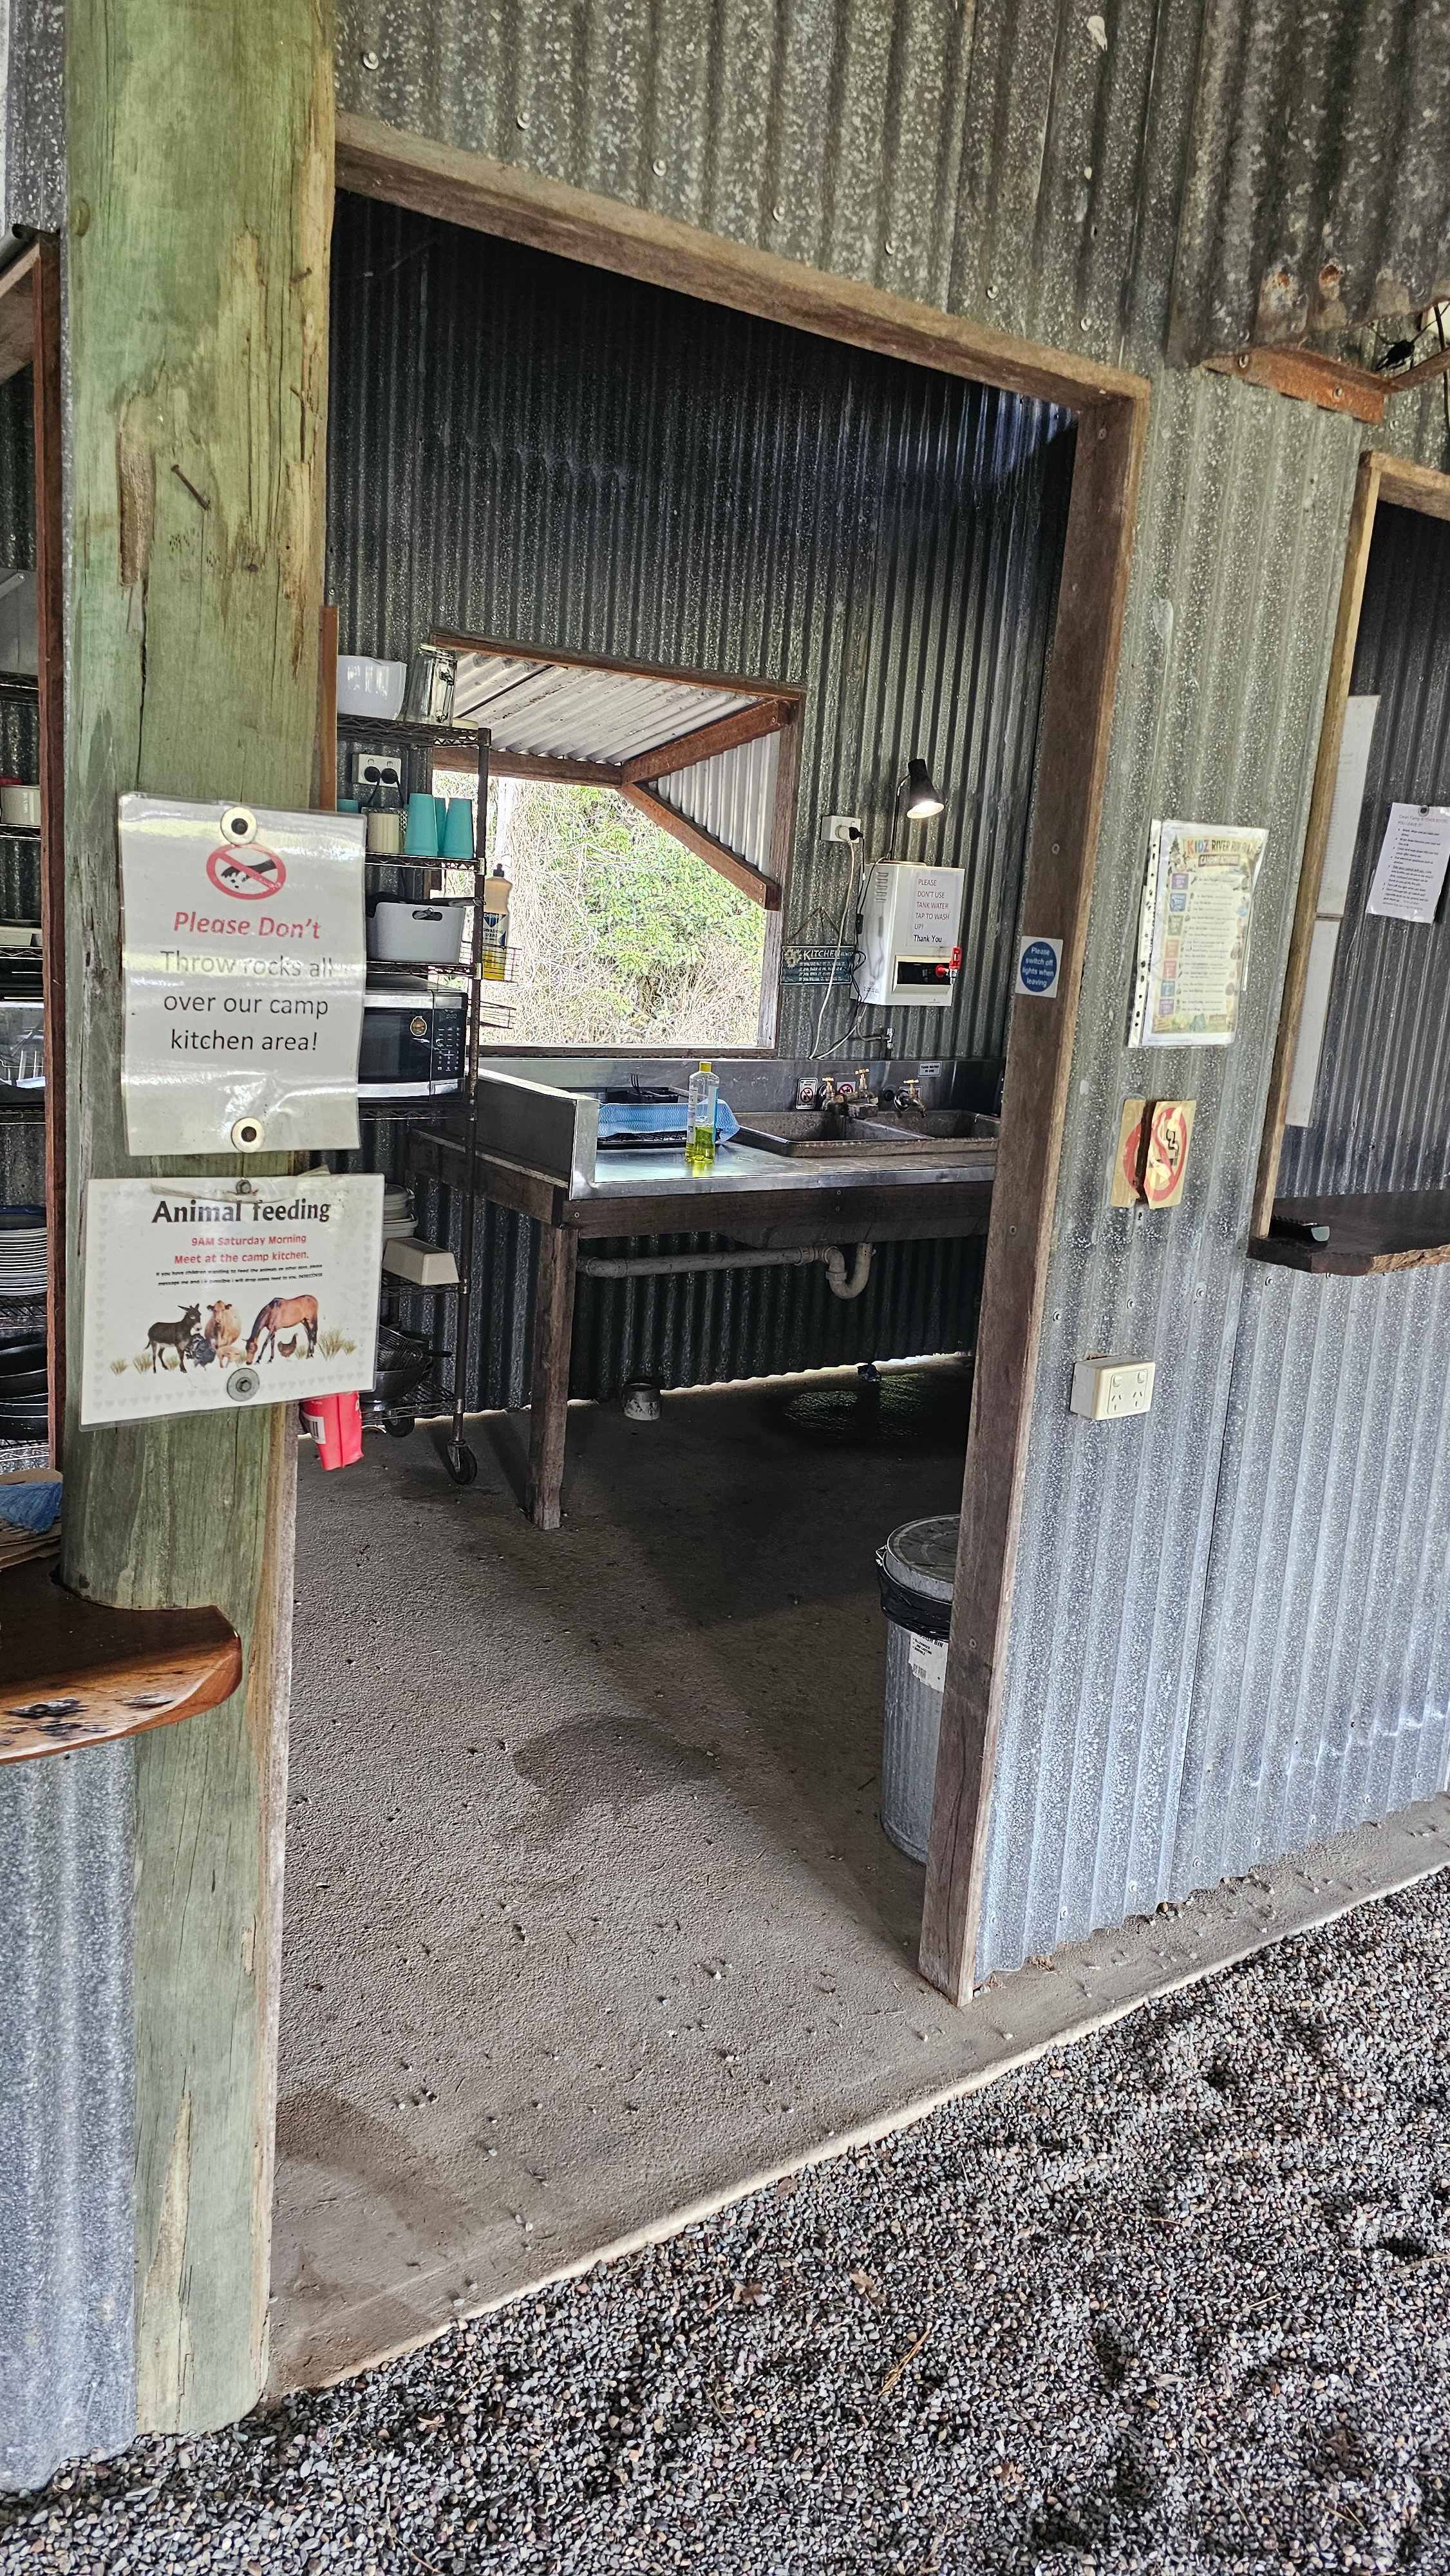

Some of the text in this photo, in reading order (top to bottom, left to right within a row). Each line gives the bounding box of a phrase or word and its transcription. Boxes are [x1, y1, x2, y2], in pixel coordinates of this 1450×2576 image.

[174, 911, 321, 939] Please Don’t
[160, 950, 332, 978] Throw rocks all
[1027, 978, 1047, 987] leaving
[164, 995, 328, 1019] over our camp
[171, 1029, 317, 1050] kitchen area!
[151, 1200, 241, 1224] Animal
[191, 1234, 306, 1247] 9AM Saturday Morning
[174, 1251, 309, 1264] Meet at the camp kitchen.
